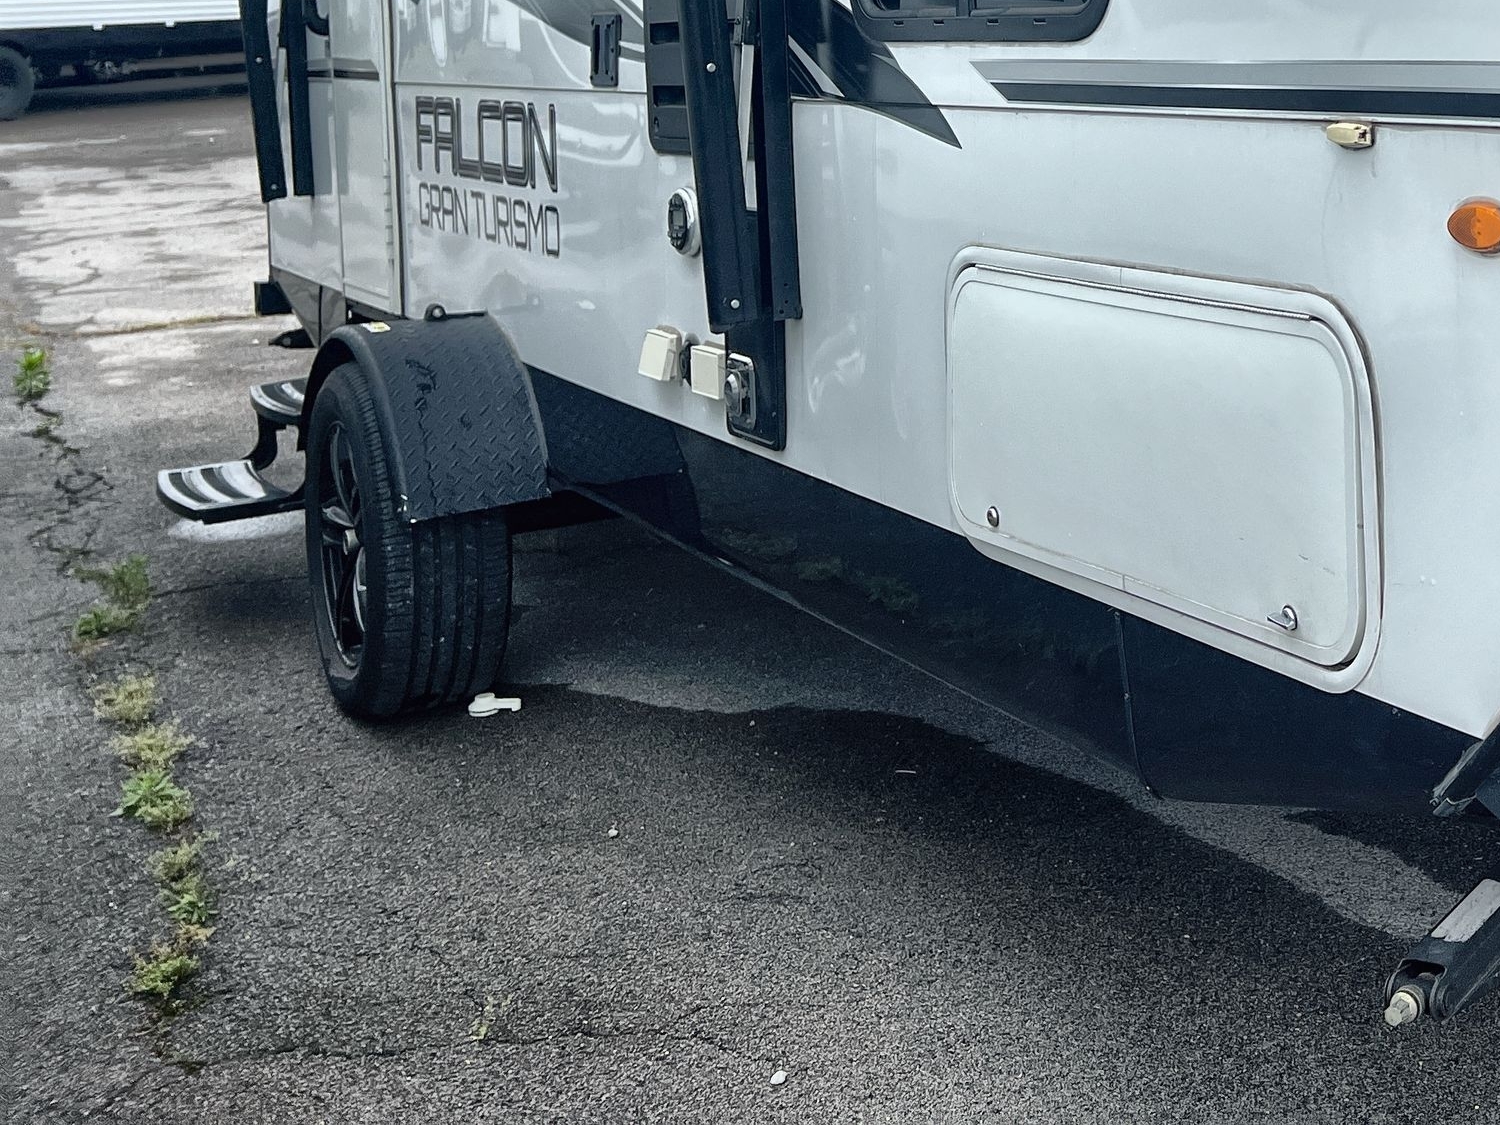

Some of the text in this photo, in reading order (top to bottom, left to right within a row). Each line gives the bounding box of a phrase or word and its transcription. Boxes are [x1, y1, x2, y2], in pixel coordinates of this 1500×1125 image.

[415, 96, 558, 193] FALCON
[418, 182, 560, 258] GRAN TURISMO
